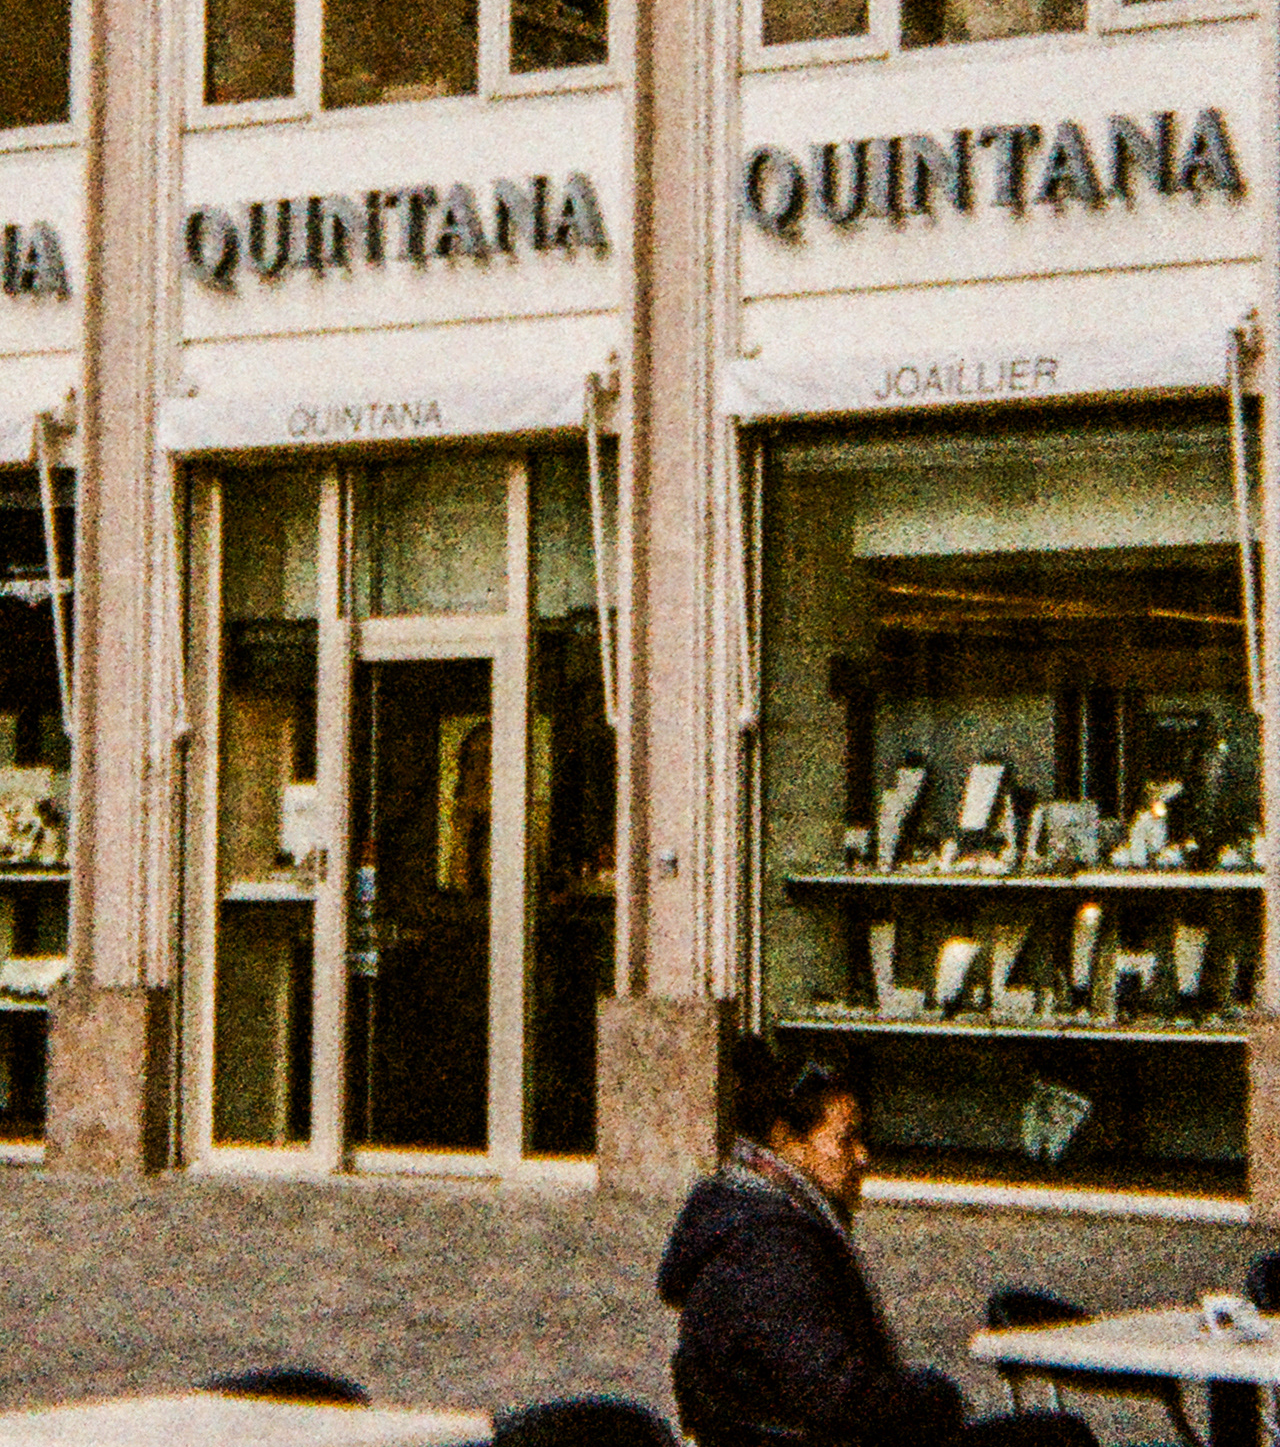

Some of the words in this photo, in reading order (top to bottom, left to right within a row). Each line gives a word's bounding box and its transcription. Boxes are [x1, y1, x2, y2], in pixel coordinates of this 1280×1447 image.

[744, 108, 1244, 241] QUINTANA
[185, 173, 610, 292] QUINTANA
[287, 399, 443, 438] QUINTANA
[875, 358, 1059, 402] JOAILLIER
